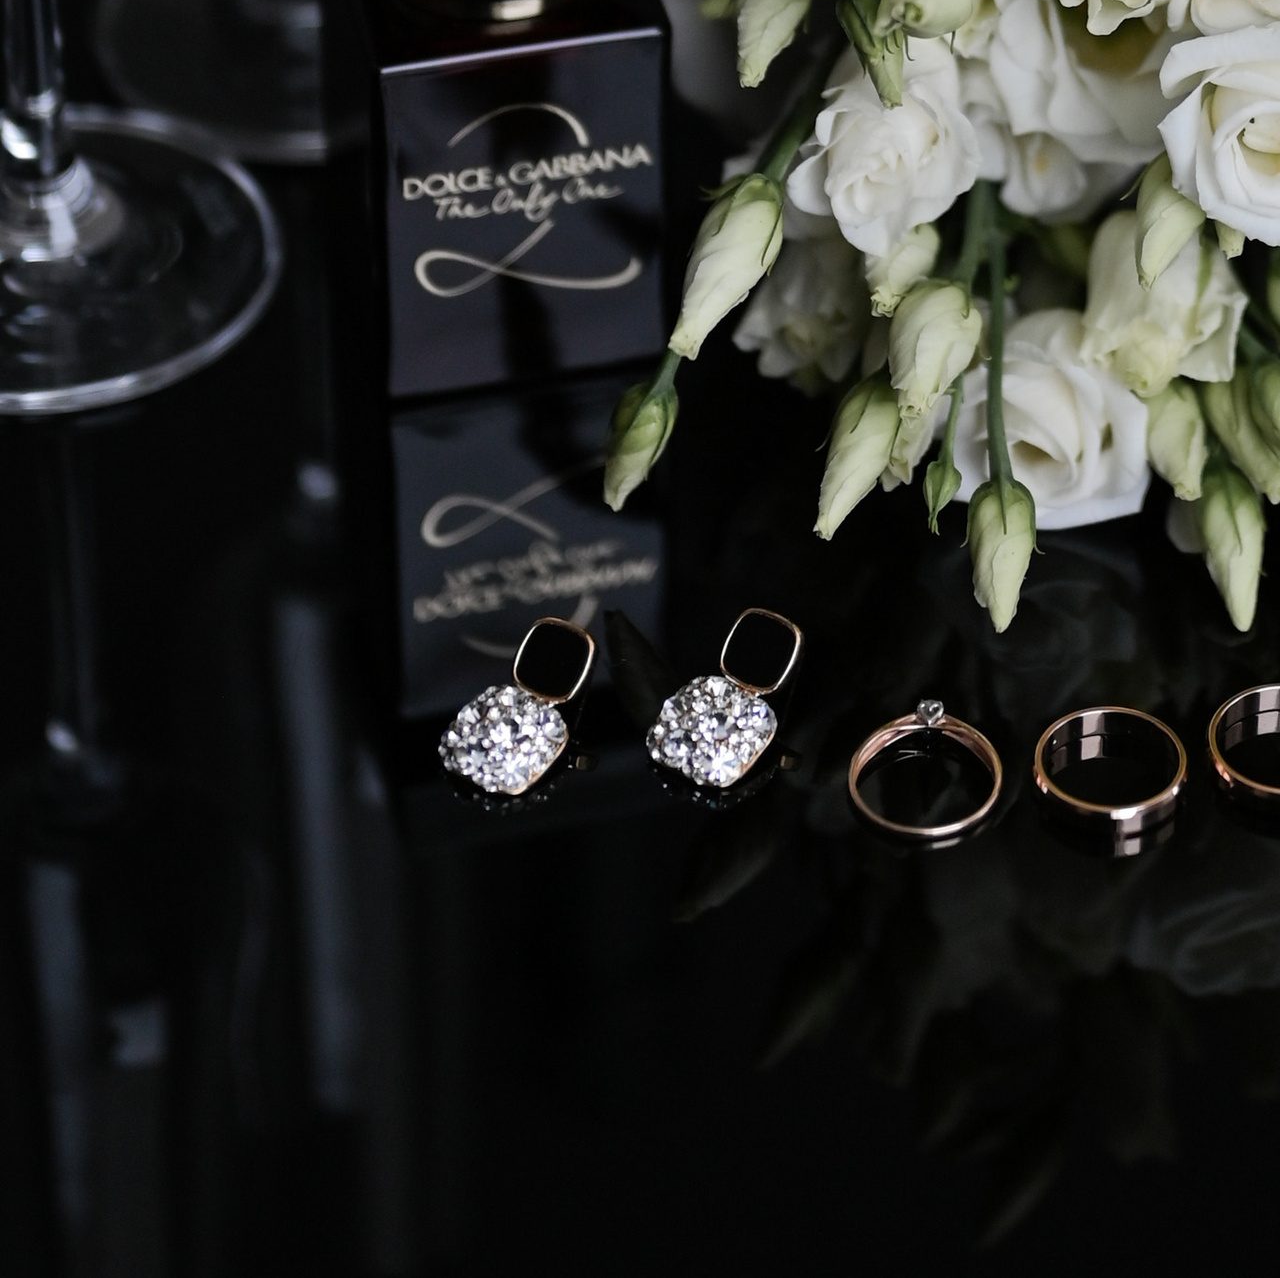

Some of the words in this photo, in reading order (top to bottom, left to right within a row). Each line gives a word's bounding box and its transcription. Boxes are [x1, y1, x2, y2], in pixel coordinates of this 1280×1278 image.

[434, 196, 490, 221] The
[491, 182, 558, 222] Only
[561, 176, 624, 203] One
